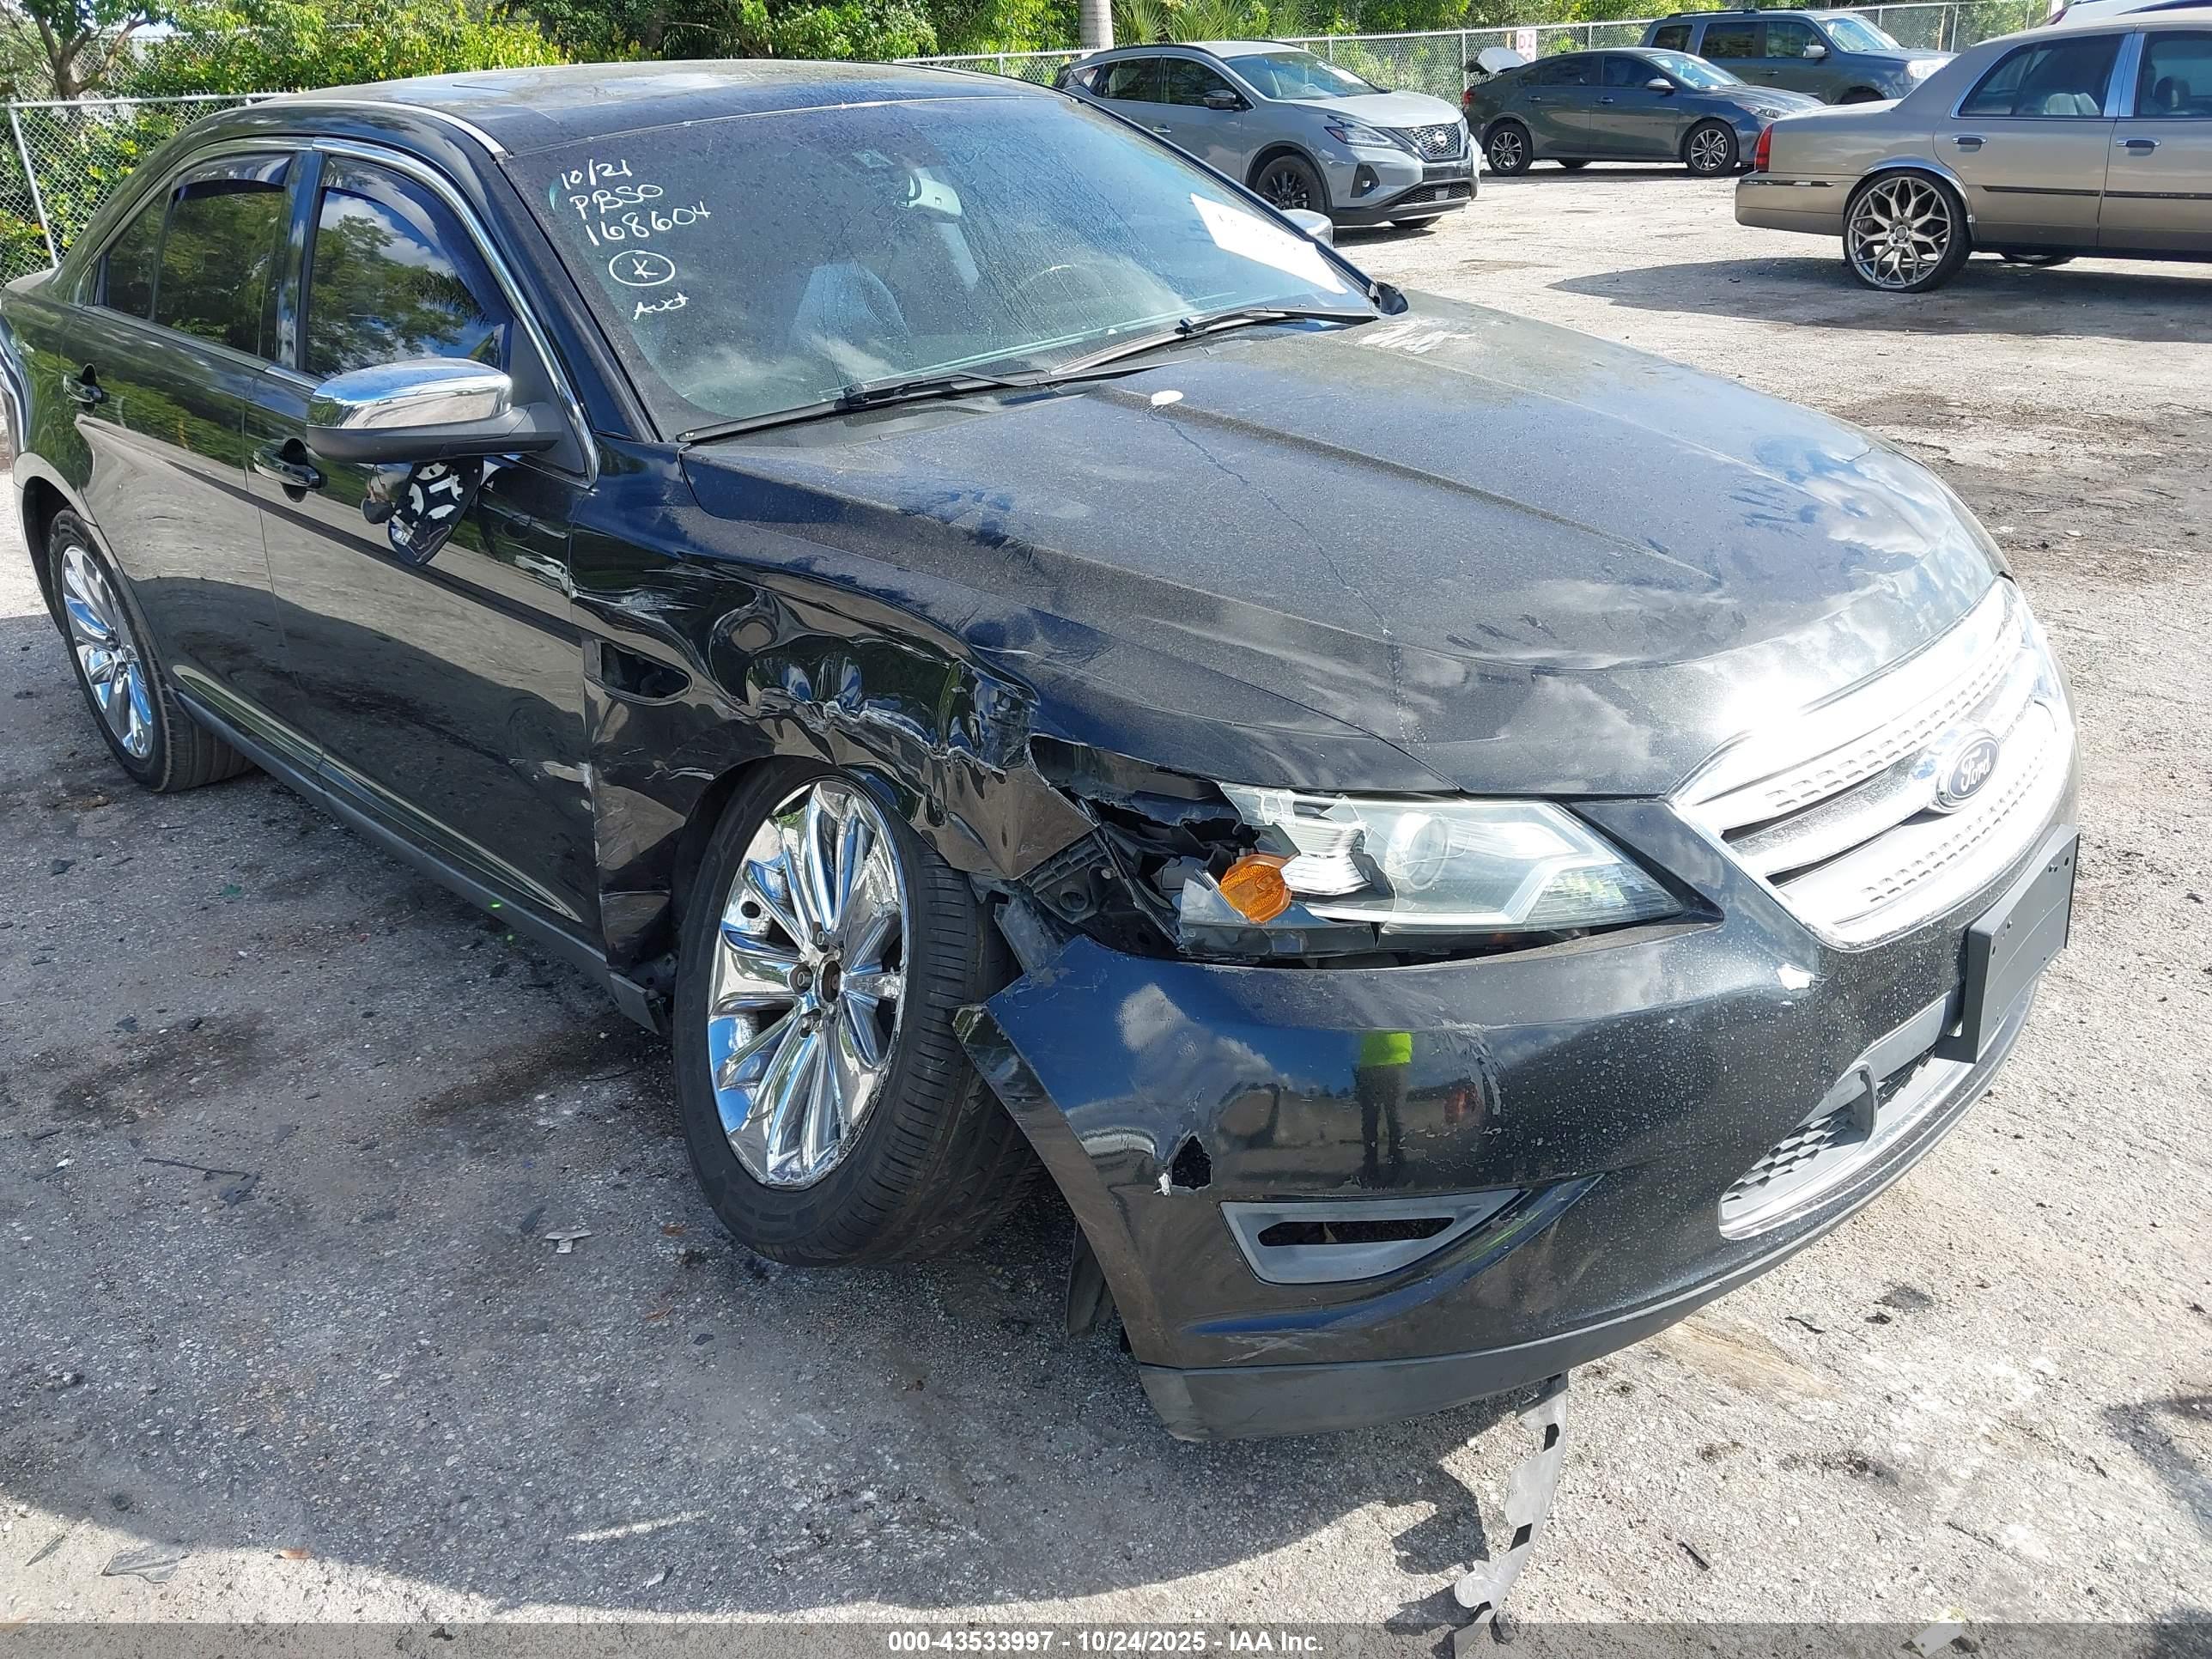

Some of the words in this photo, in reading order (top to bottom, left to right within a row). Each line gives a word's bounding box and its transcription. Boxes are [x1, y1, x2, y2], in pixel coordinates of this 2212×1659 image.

[561, 159, 633, 190] 10/21
[569, 184, 664, 220] PBSO
[586, 200, 712, 246] 168604
[1960, 746, 1992, 793] Ford
